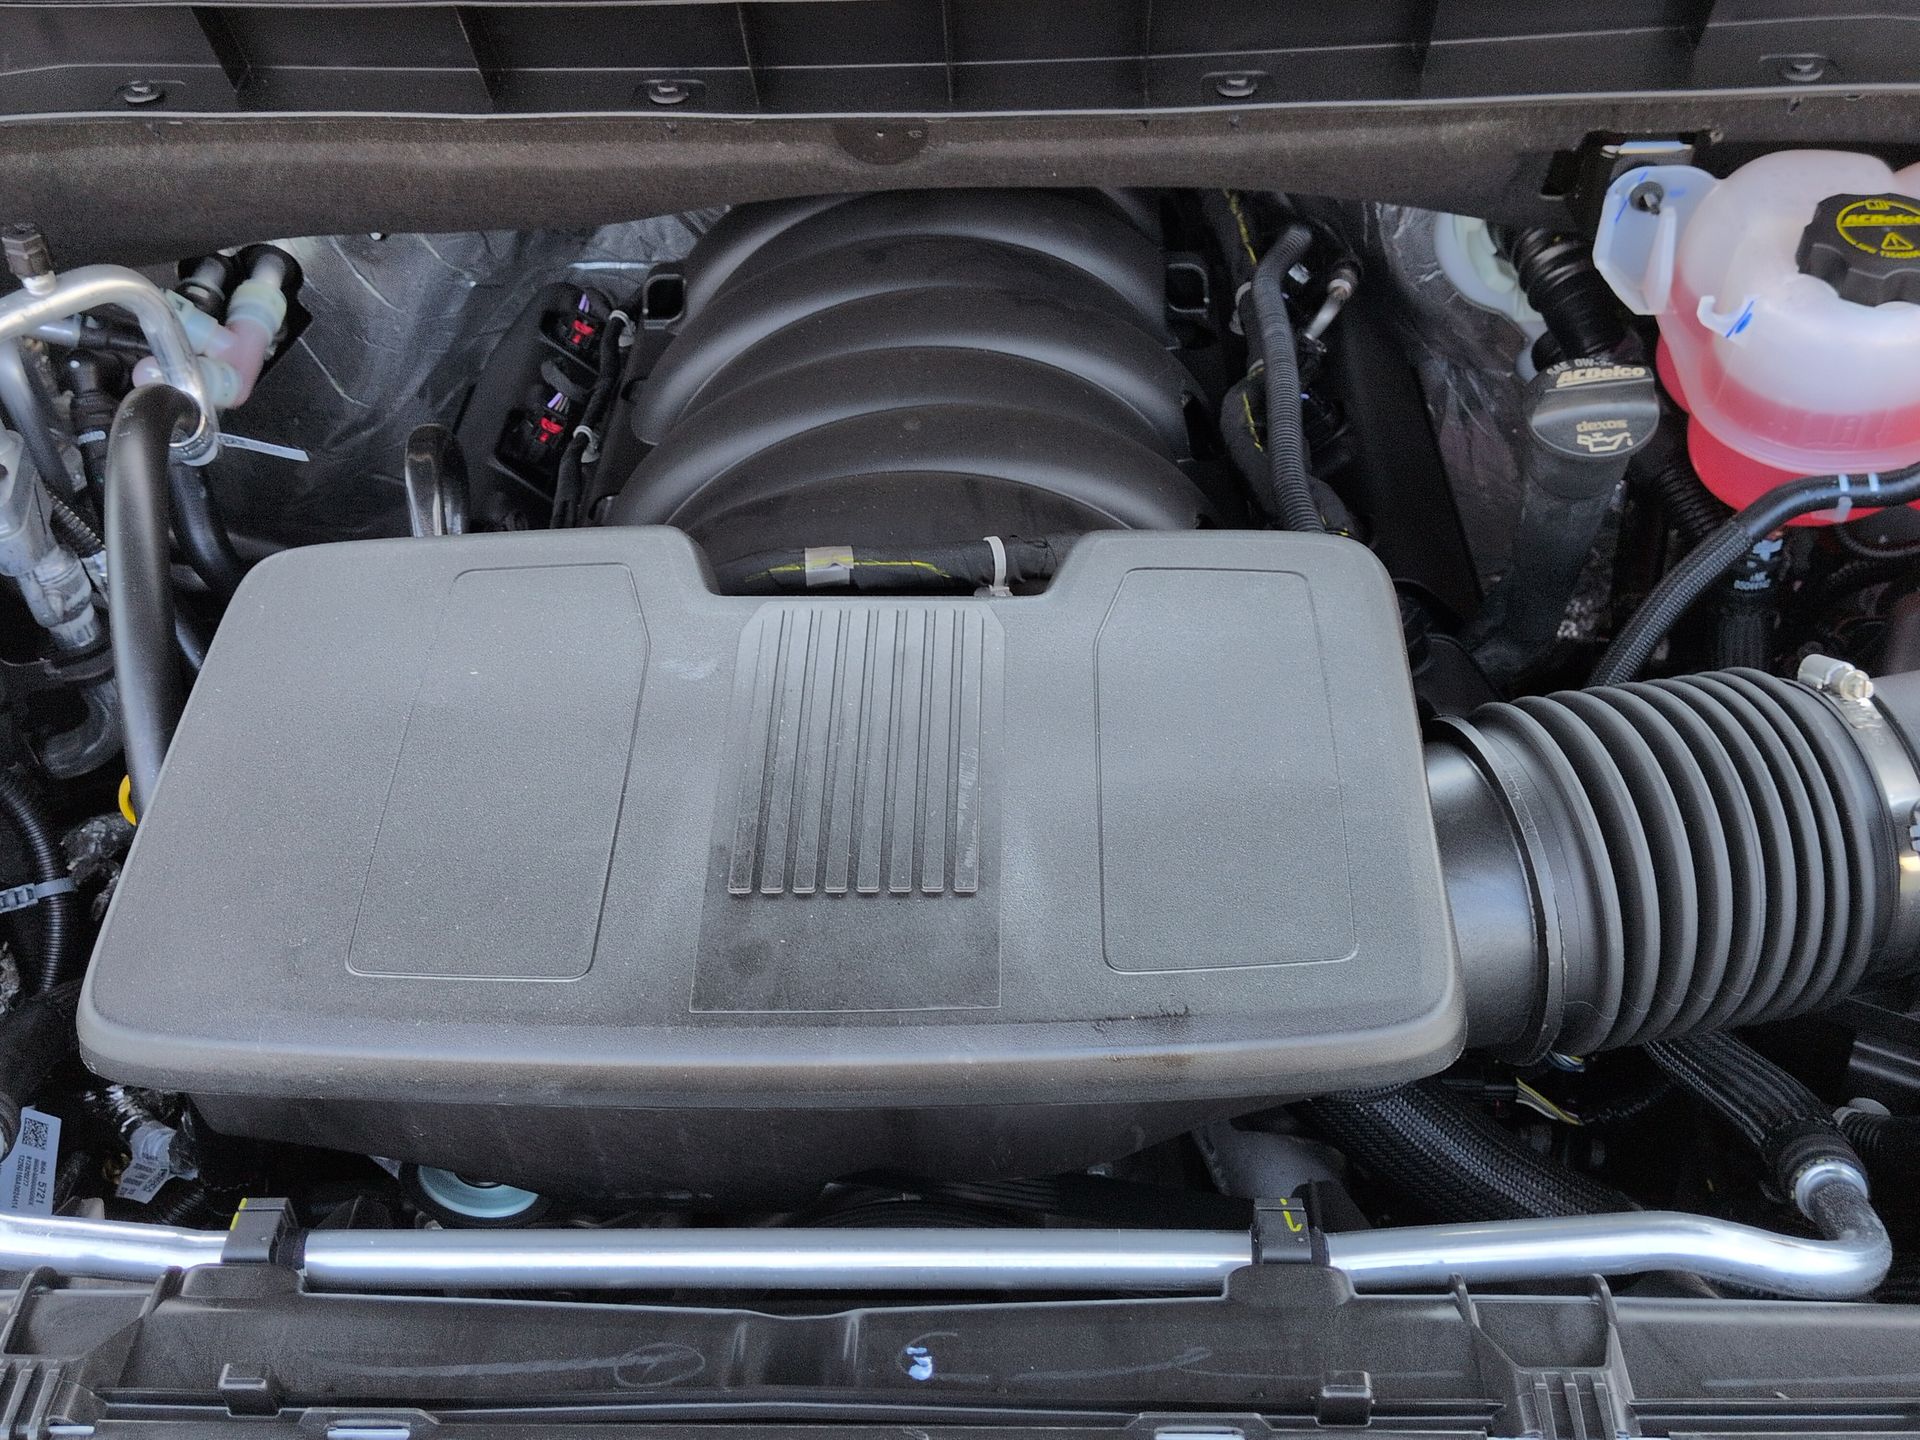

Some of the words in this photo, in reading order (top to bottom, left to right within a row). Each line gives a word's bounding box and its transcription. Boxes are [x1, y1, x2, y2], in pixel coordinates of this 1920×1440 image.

[1546, 361, 1571, 377] SAE
[1556, 365, 1646, 387] ACDelco
[1576, 420, 1628, 432] dexos
[36, 1181, 47, 1204] 5721
